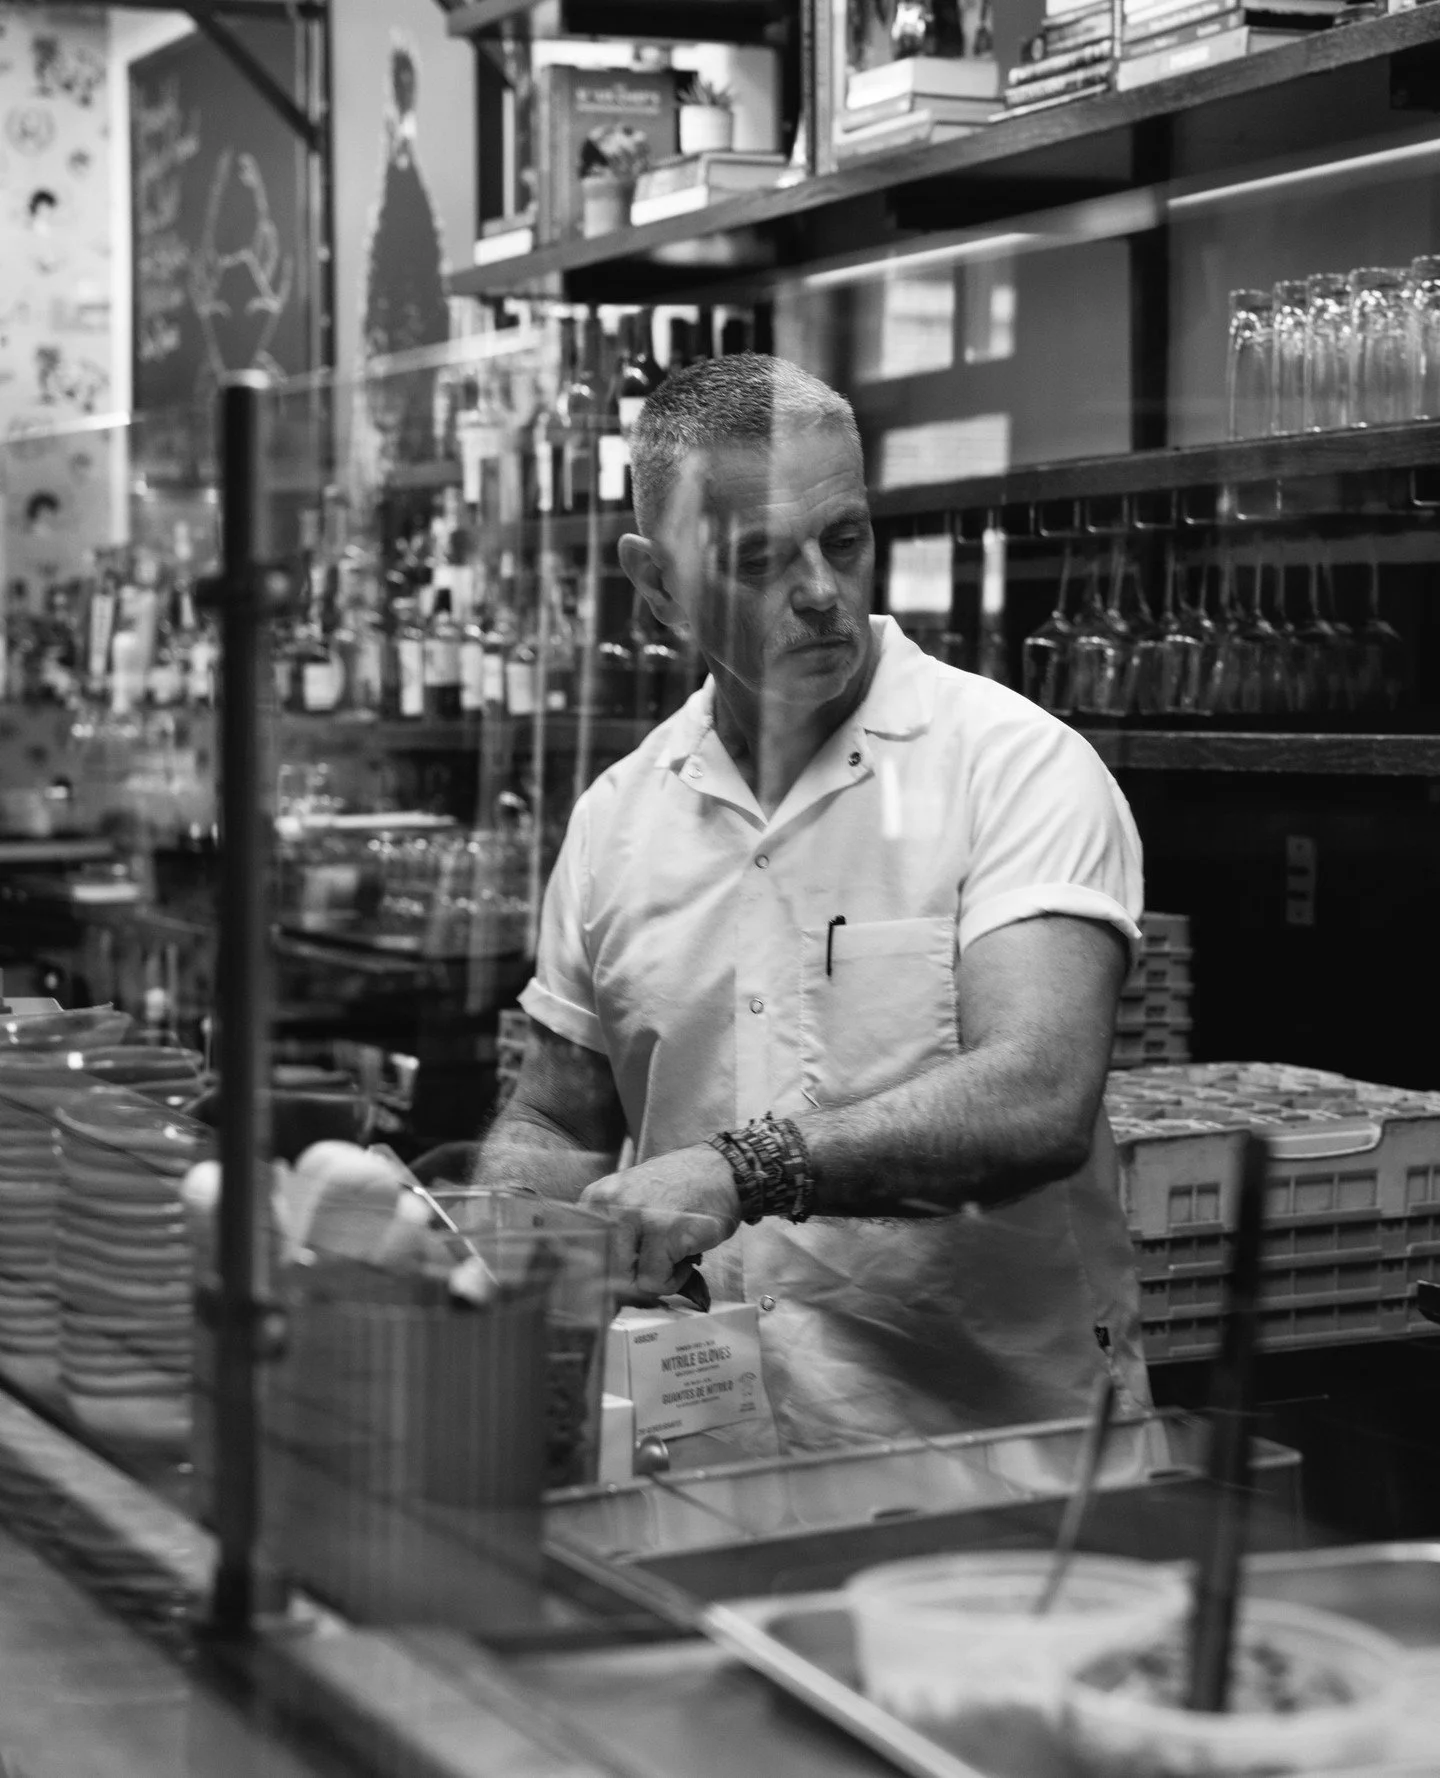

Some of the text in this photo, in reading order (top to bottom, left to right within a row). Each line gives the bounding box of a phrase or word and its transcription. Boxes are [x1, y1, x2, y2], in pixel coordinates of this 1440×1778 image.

[661, 1353, 696, 1372] NITRILE
[697, 1345, 731, 1364] GLOVES
[662, 1388, 695, 1405] GUANTES
[696, 1385, 706, 1398] DE
[706, 1380, 734, 1394] NITRILO
